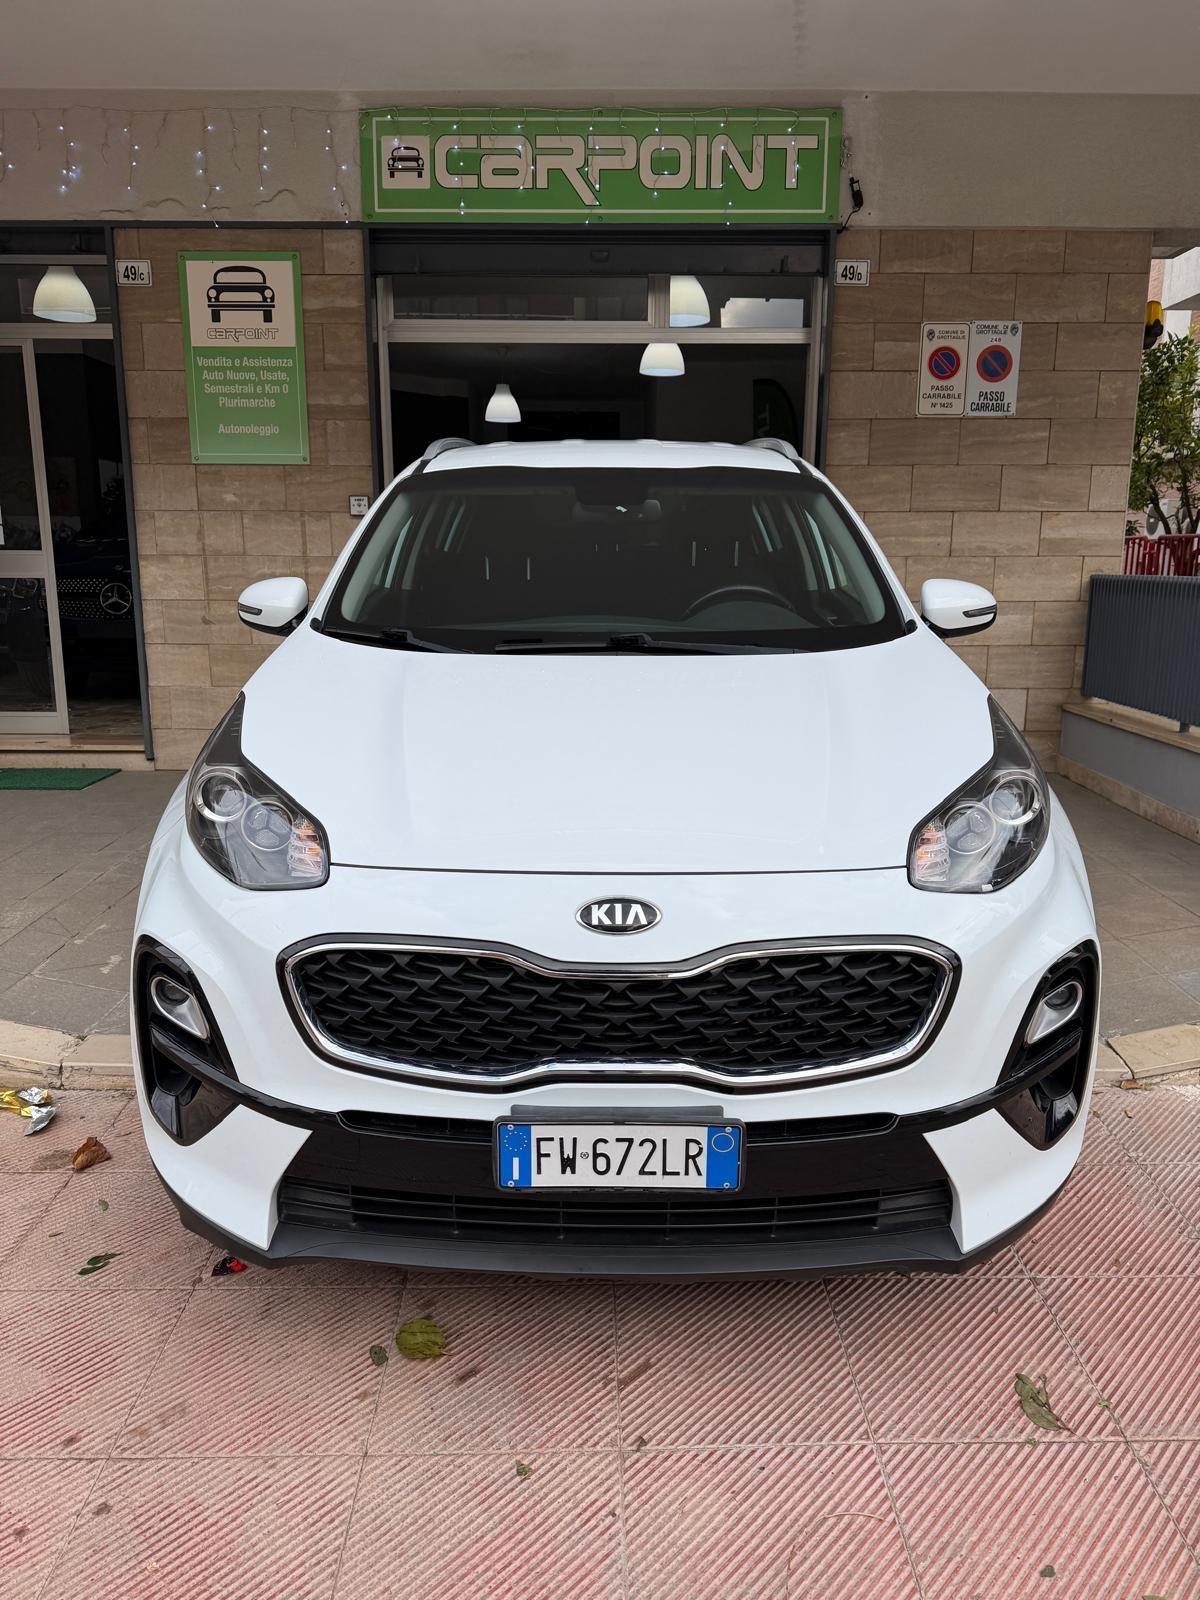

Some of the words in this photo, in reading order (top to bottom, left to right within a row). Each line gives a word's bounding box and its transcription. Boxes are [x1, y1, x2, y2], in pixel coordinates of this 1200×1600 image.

[197, 356, 233, 367] Vendita
[234, 358, 241, 367] e
[242, 356, 293, 367] Assistenza
[202, 370, 224, 380] Auto
[226, 370, 259, 382] Nuove,
[260, 370, 290, 382] Usate,
[204, 383, 254, 394] Semestrali
[256, 385, 263, 394] e
[264, 383, 281, 394] Km
[218, 396, 276, 408] Plurimarche
[978, 391, 1005, 402] PASSO
[970, 402, 1012, 413] CARRABILE
[218, 423, 280, 436] Autonoleggio
[590, 903, 648, 926] KIA
